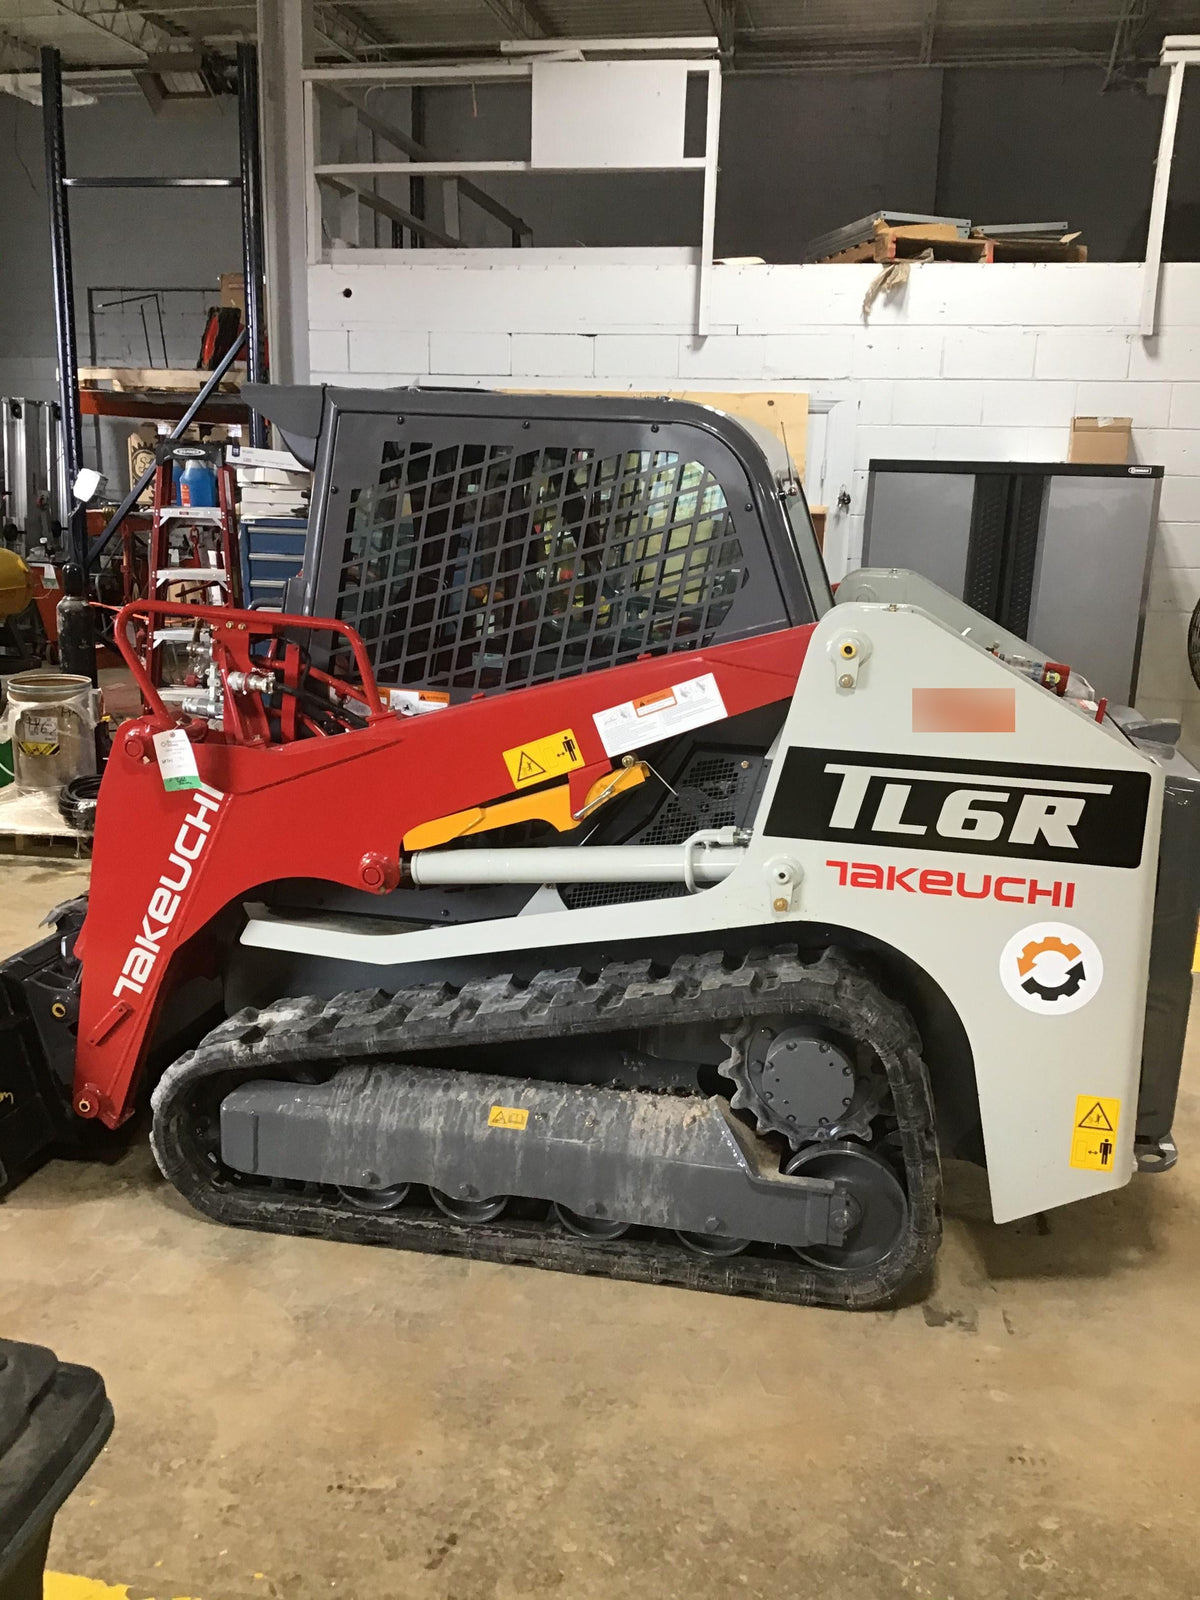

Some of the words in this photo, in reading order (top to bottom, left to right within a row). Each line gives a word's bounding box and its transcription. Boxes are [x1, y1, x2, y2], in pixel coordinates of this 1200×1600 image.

[823, 763, 1114, 849] TL6R
[112, 783, 225, 998] TAKEUCHI
[825, 859, 1076, 908] TAKEUCHI
